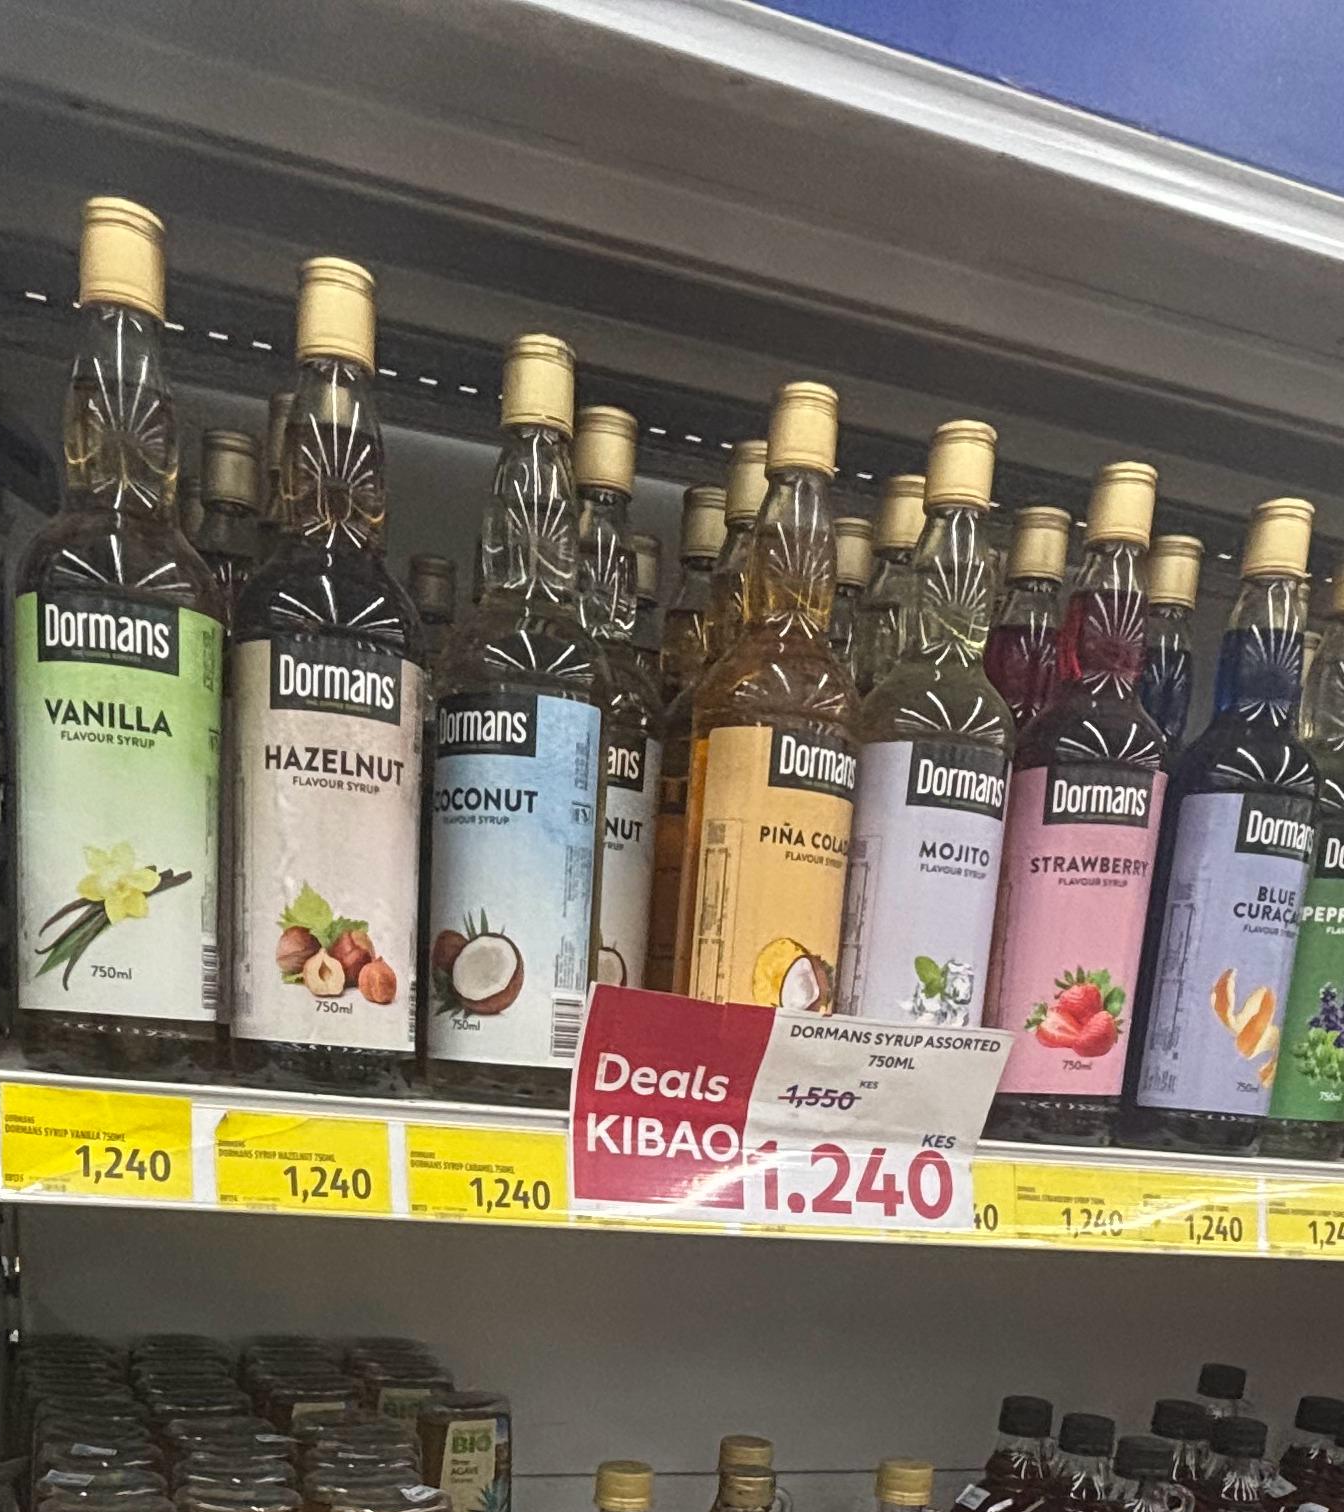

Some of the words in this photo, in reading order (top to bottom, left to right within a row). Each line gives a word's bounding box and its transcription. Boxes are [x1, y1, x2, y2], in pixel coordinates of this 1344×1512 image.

[44, 604, 171, 661] Dormans
[278, 654, 395, 711] Dormans
[44, 698, 172, 738] VANILLA
[438, 707, 528, 745] Dormans
[60, 730, 114, 746] FLAVOUR
[116, 734, 155, 751] SYRUP
[264, 745, 404, 787] HAZELNUT
[779, 735, 855, 789] Dormans
[292, 776, 345, 792] FLAVOUR
[347, 781, 380, 796] SYRUP
[916, 759, 1004, 808] Dormans
[1053, 780, 1147, 817] Dormans
[759, 821, 805, 847] PIÑA
[1246, 811, 1313, 852] Dormans
[786, 852, 822, 865] FLAVOUR
[918, 840, 990, 867] MOJITO
[1030, 856, 1147, 878] STRAWBERRY
[920, 864, 961, 877] FLAVOUR
[1058, 878, 1101, 887] FLAVOUR
[1257, 887, 1296, 905] BLUE
[91, 965, 132, 983] 750ml
[315, 1000, 353, 1017] 750ml
[452, 1018, 480, 1032] 750ml
[790, 1024, 873, 1047] DORMANS
[874, 1031, 923, 1050] SYRUP
[924, 1034, 1001, 1053] ASSORTED
[594, 1052, 730, 1103] Deals
[868, 1055, 916, 1070] 750ML
[1062, 1059, 1092, 1071] 750ml
[784, 1084, 855, 1111] 1,550
[859, 1080, 879, 1090] KES
[585, 1112, 740, 1163] KIBAO
[921, 1133, 956, 1150] KES
[75, 1145, 171, 1184] 1,240
[747, 1140, 954, 1219] 1.240
[283, 1165, 372, 1203] 1,240
[469, 1177, 550, 1213] 1,240
[1061, 1208, 1123, 1238] 1,240
[1184, 1214, 1243, 1245] 1,240
[451, 1430, 491, 1454] BIO
